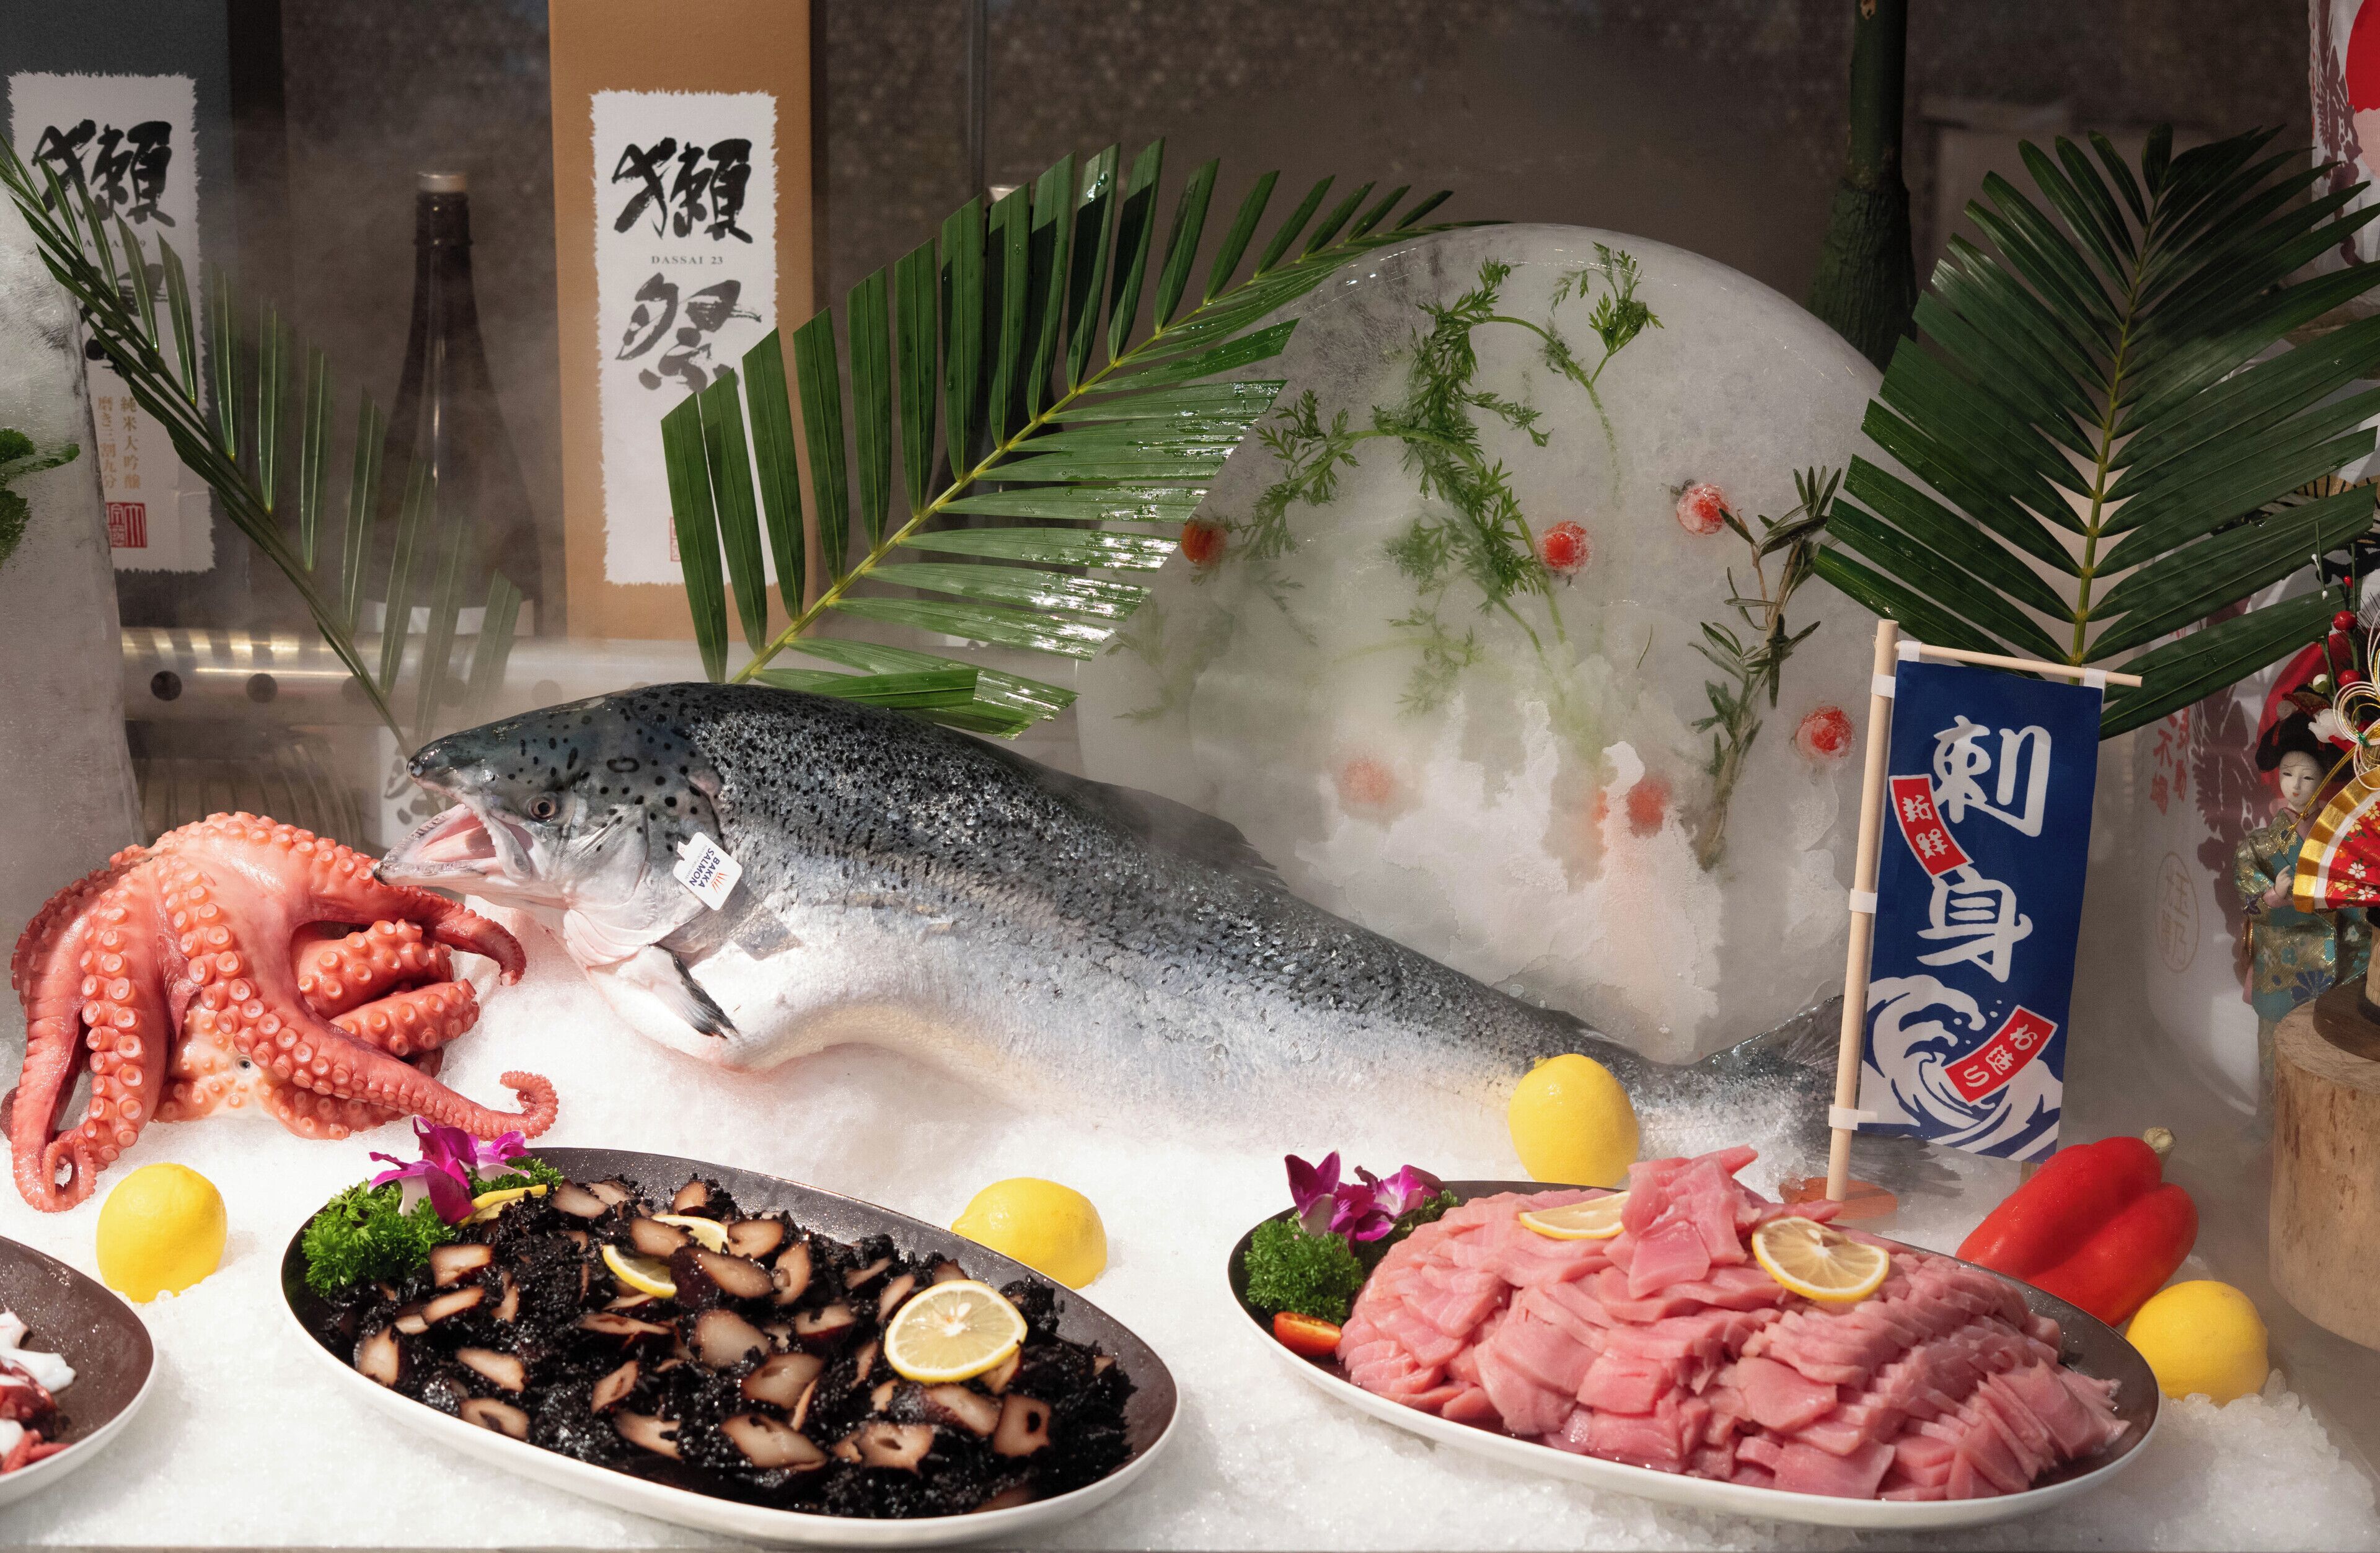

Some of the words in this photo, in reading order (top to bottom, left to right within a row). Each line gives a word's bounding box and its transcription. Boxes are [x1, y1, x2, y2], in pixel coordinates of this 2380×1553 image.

[651, 255, 703, 265] DASSAI
[710, 255, 724, 265] 23
[1902, 794, 1949, 859] 新鮮
[1916, 715, 2052, 983] 刺身
[689, 848, 715, 887] SALMON
[698, 856, 721, 888] BAKKA
[1963, 1024, 2038, 1088] お造り
